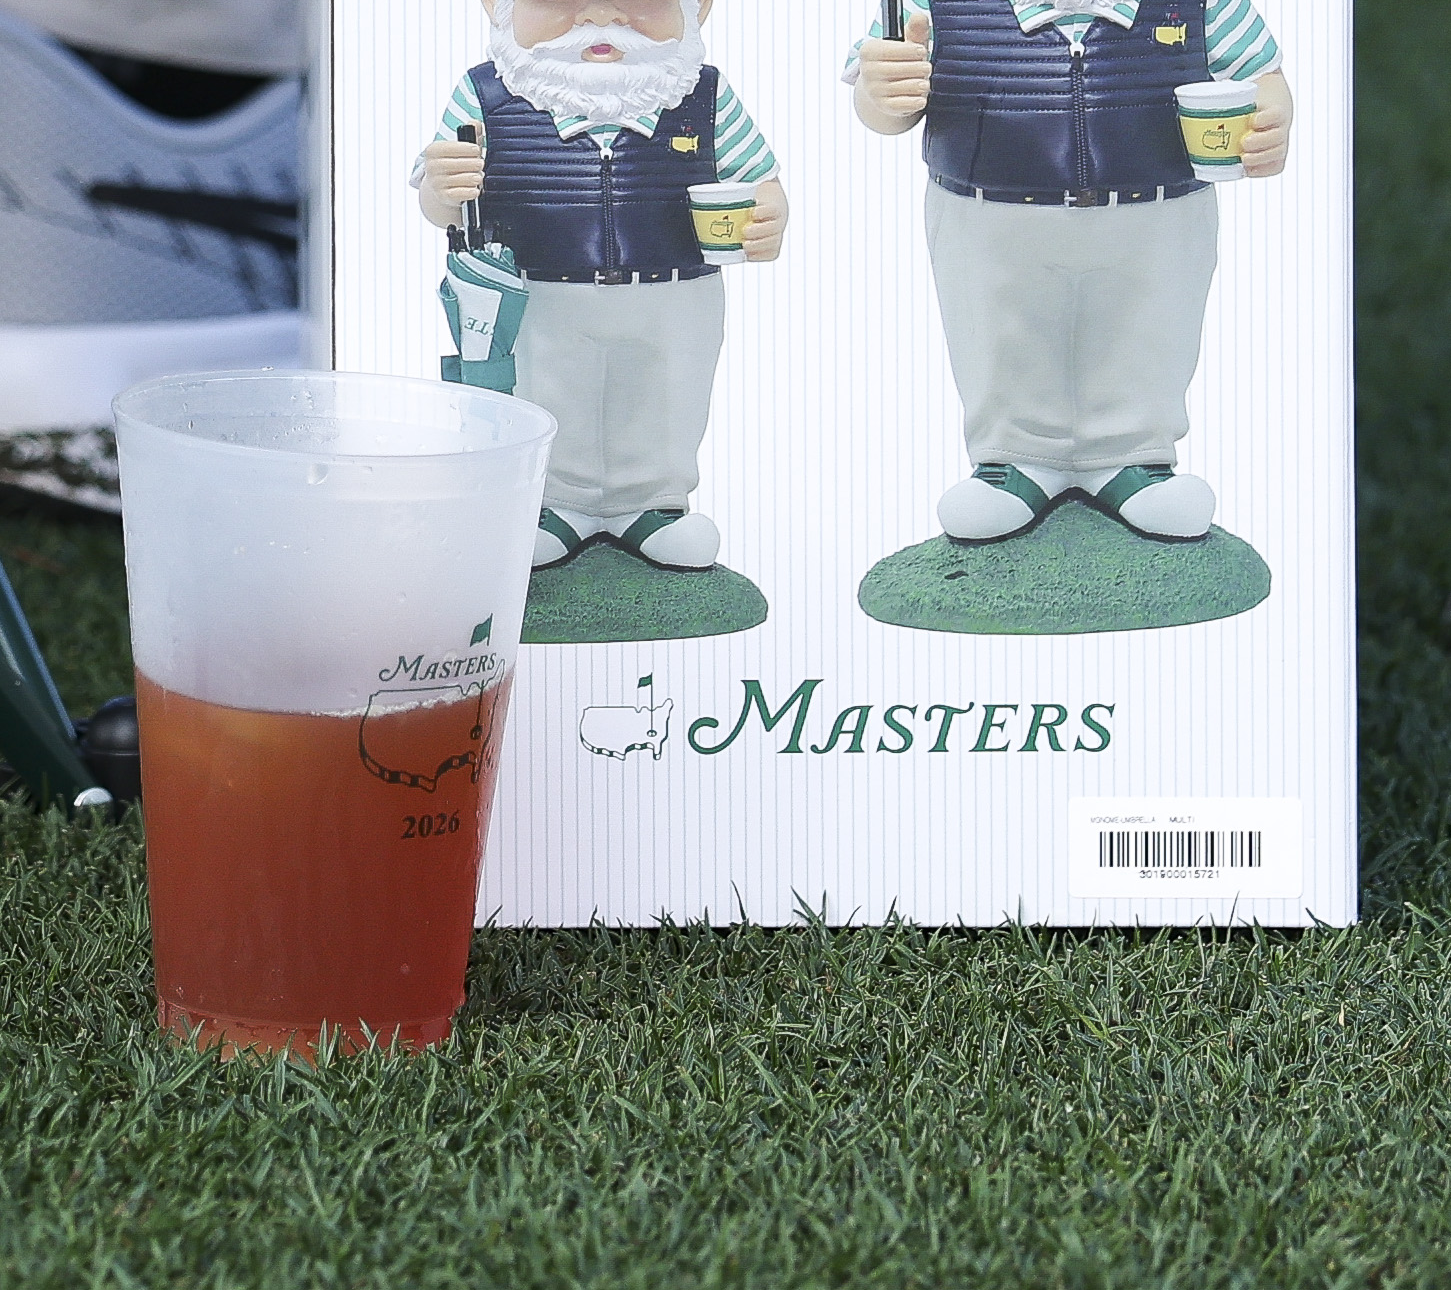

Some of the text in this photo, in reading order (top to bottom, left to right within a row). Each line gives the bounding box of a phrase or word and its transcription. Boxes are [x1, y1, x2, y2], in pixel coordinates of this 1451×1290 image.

[379, 652, 497, 682] MASTERS
[687, 678, 1116, 756] MASTERS
[400, 810, 460, 839] 2026
